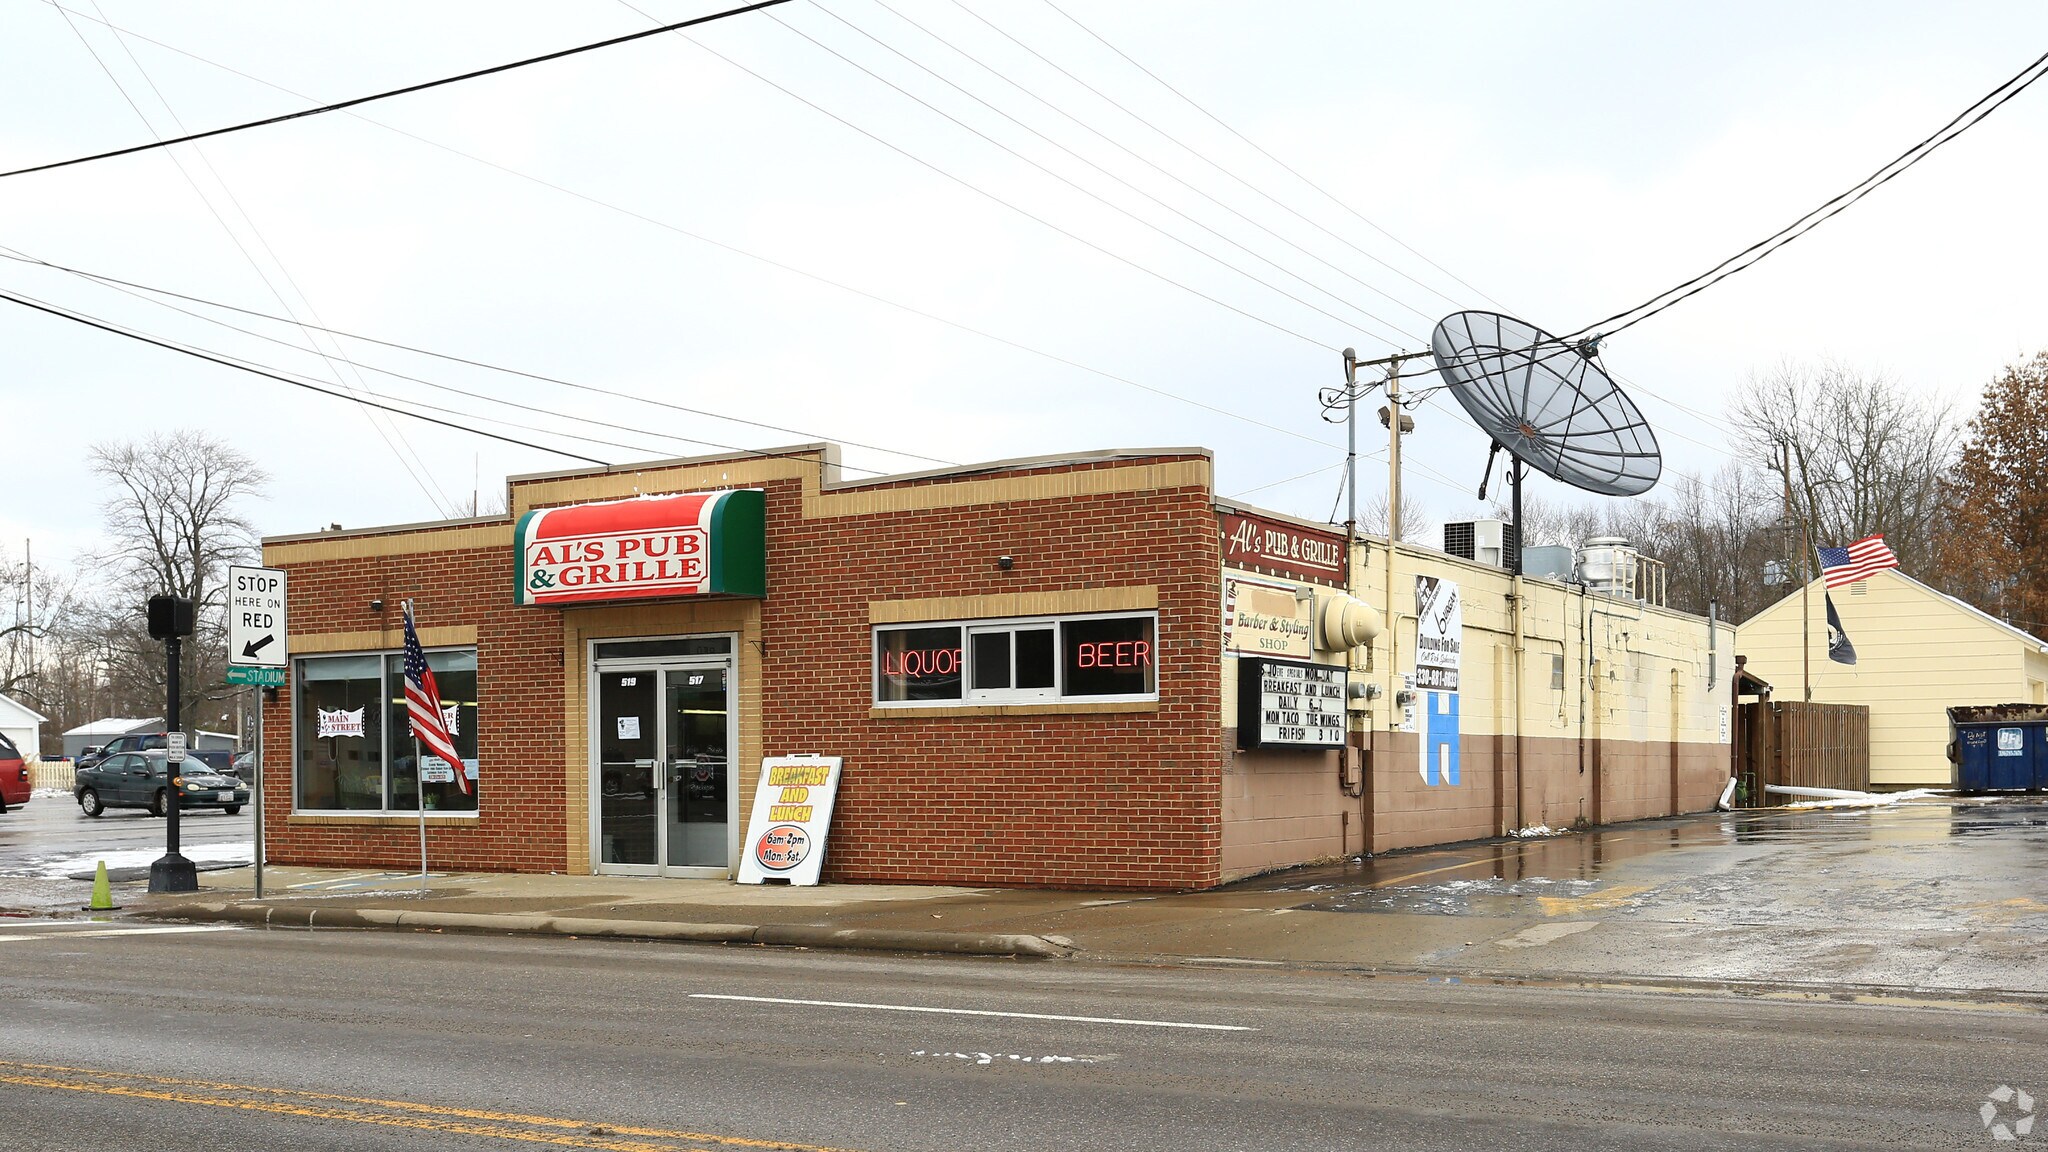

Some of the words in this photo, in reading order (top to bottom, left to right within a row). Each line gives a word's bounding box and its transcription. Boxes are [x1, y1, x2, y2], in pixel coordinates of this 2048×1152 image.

[530, 541, 605, 567] AL'S
[616, 534, 701, 560] PUB
[1229, 519, 1262, 555] Al's
[1265, 530, 1289, 557] PUB
[1291, 535, 1300, 559] &
[1301, 538, 1339, 567] GRILLE
[558, 557, 702, 586] GRILLE
[237, 576, 278, 593] STOP
[235, 596, 262, 608] HERE
[267, 599, 281, 609] ON
[242, 612, 273, 629] RED
[1238, 612, 1268, 631] Barber
[1269, 617, 1279, 633] &
[1280, 619, 1309, 641] Styling
[1259, 637, 1288, 651] SHOP
[1078, 640, 1151, 668] BEER
[246, 669, 285, 683] STADIUM
[621, 677, 637, 687] 519
[688, 675, 704, 685] 517
[1263, 679, 1302, 693] BREAKFAST
[1305, 683, 1317, 696] AND
[1321, 684, 1340, 698] LUNCH
[1279, 695, 1299, 708] DAILY
[327, 715, 349, 723] MAIN
[331, 723, 361, 731] STREET
[1265, 710, 1280, 724] MON
[1282, 711, 1299, 725] TACO
[1306, 713, 1318, 726] TUE
[1320, 714, 1340, 728] WINGS
[768, 765, 831, 787] BREAKFAST
[778, 787, 809, 803] AND
[768, 805, 814, 822] LUNCH
